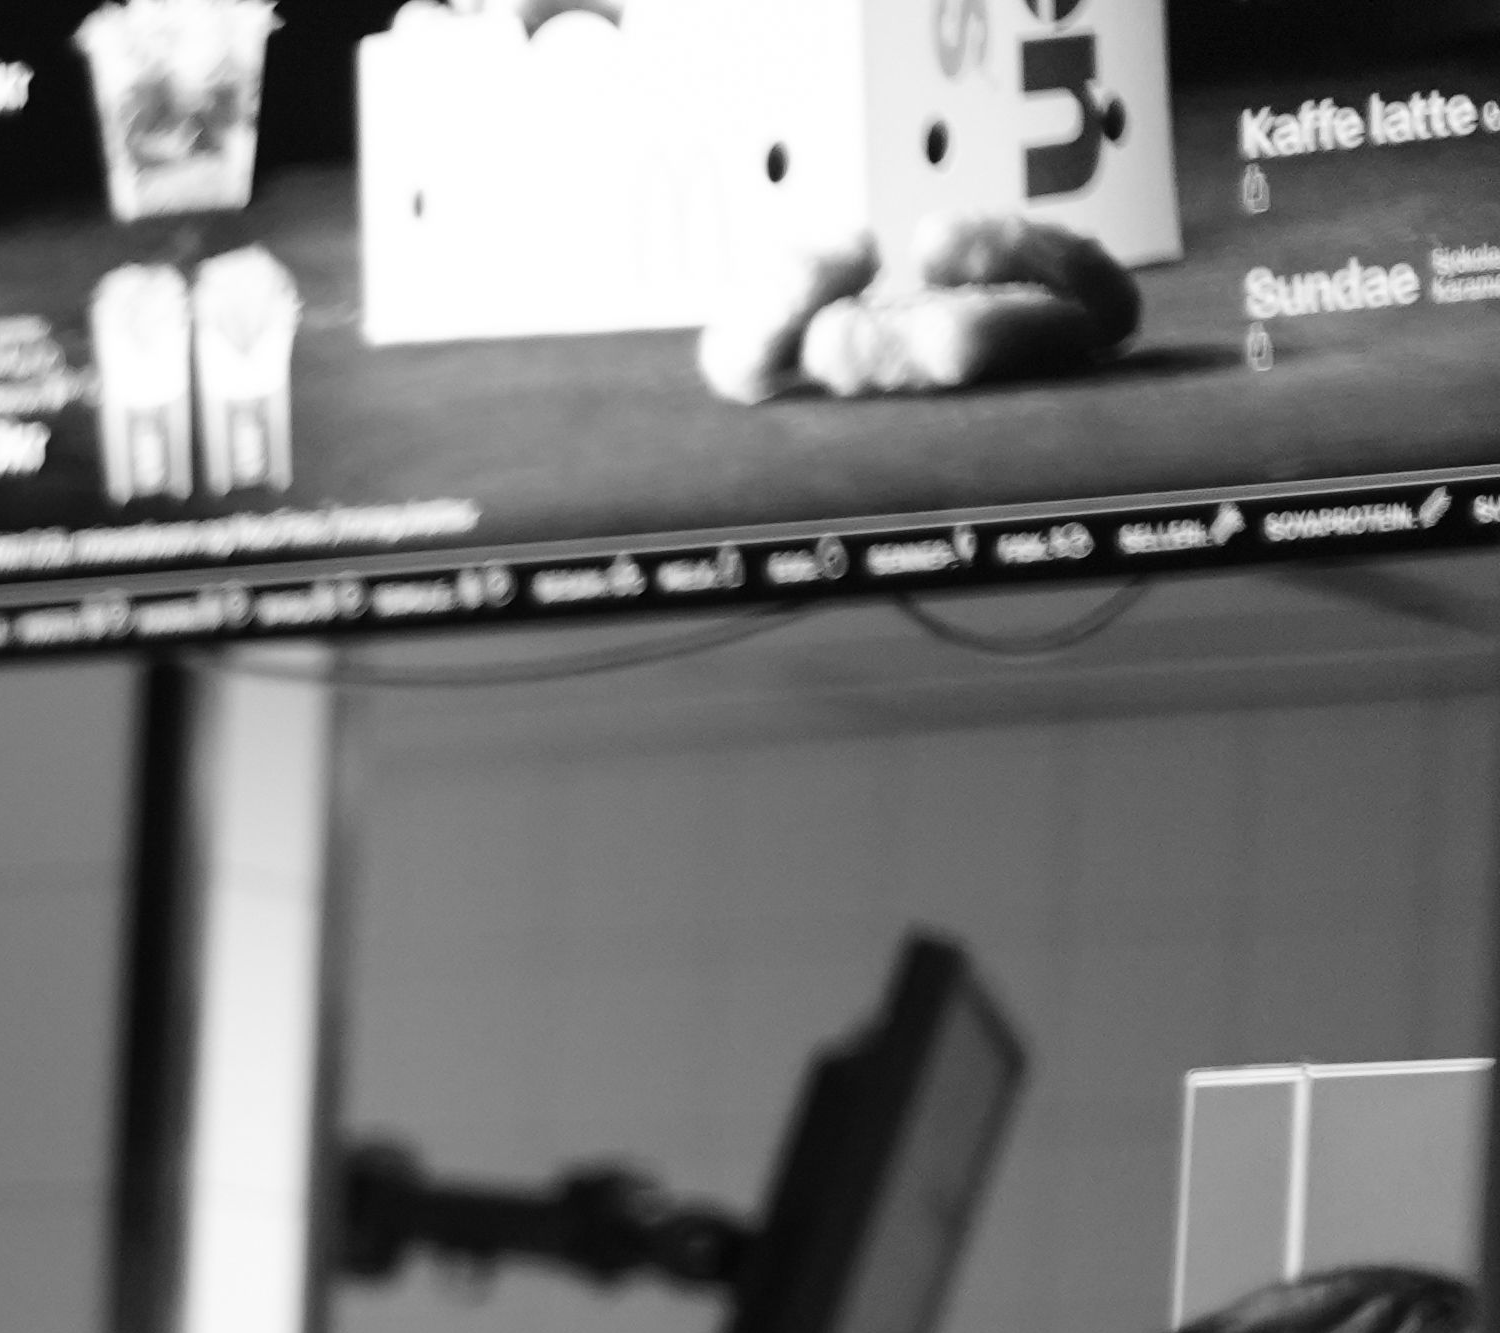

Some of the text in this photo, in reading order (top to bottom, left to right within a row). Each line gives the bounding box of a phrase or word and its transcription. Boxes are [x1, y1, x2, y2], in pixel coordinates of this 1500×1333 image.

[1241, 98, 1365, 158] Kaffe
[1369, 90, 1478, 146] latte
[1246, 258, 1419, 318] Sundae
